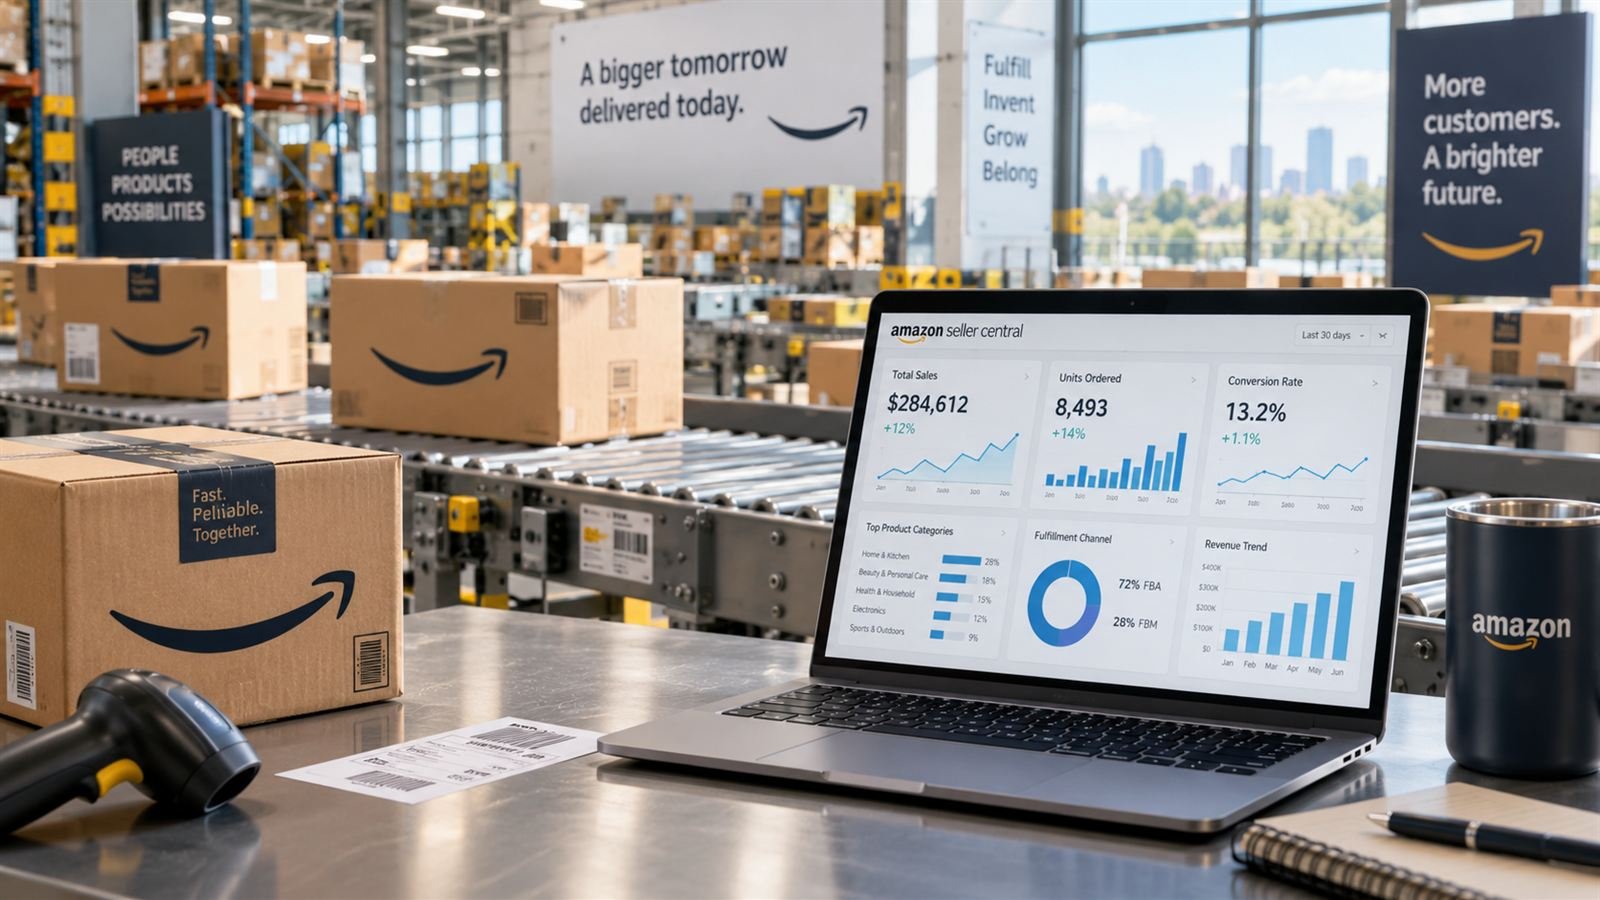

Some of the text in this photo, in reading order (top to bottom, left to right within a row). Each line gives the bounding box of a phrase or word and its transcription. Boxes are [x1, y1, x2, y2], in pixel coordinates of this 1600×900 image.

[581, 46, 787, 90] A bigger tomorrow
[985, 53, 1031, 79] Fulfill
[1425, 73, 1486, 99] More
[580, 89, 743, 124] delivered today.
[984, 89, 1034, 114] Invent
[1424, 109, 1560, 134] customers.
[984, 124, 1027, 147] Grow
[122, 145, 178, 166] PEOPLE
[1423, 142, 1543, 175] A brighter
[983, 160, 1038, 189] Belong
[112, 173, 193, 194] PRODUCTS
[1422, 179, 1502, 205] future.
[102, 201, 205, 222] POSSIBILITIES
[891, 323, 1023, 337] amazon seller central
[1302, 331, 1350, 341] Last 30 days
[893, 370, 937, 380] Total Sales
[1060, 373, 1122, 383] Units Ordered
[1228, 376, 1303, 386] Conversion Rate
[888, 393, 968, 415] $284,612
[1056, 398, 1107, 419] 8,493
[1227, 402, 1286, 422] 13.2%
[884, 423, 915, 434] +12%
[1053, 428, 1085, 439] +14%
[1222, 432, 1260, 445] +1.1%
[193, 488, 226, 503] Fast.
[193, 524, 259, 544] Together.
[867, 523, 953, 536] Top Product Categories
[1035, 531, 1112, 543] Fulfillment Channel
[1205, 539, 1267, 551] Revenue Trend
[862, 550, 880, 558] Home
[985, 558, 999, 566] 28%
[858, 568, 880, 578] Beauty
[887, 570, 913, 579] Personal
[914, 572, 928, 580] Care
[983, 577, 996, 585] 18%
[1119, 579, 1161, 591] 72% FBA
[883, 589, 915, 598] Household
[978, 596, 991, 604] 15%
[853, 605, 886, 614] Electronics
[974, 615, 987, 623] 12%
[1113, 617, 1157, 629] 28% FBM
[850, 624, 869, 632] Sports
[876, 626, 904, 635] Outdoors
[1193, 624, 1212, 632] $100K
[1472, 613, 1570, 641] amazon
[969, 634, 978, 642] 9%
[1221, 659, 1234, 667] Jan
[1286, 664, 1299, 674] Apr
[1308, 666, 1322, 675] May
